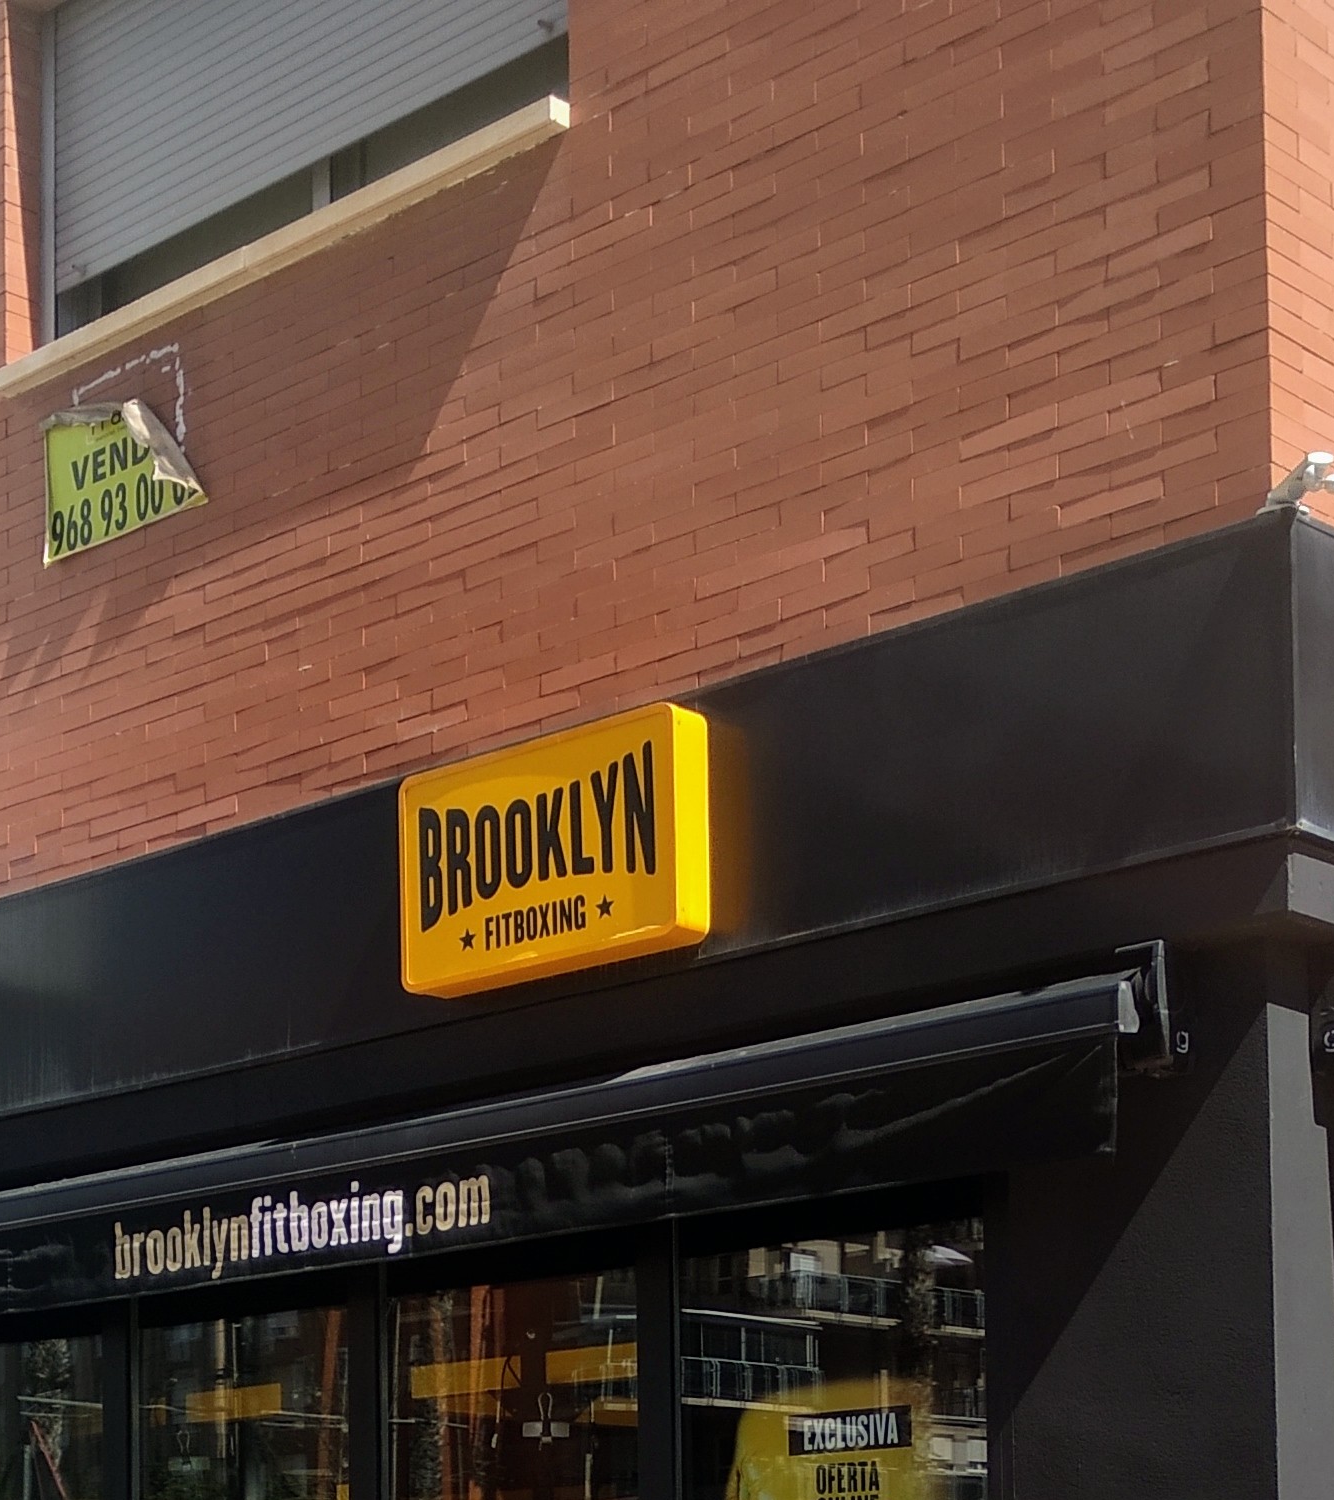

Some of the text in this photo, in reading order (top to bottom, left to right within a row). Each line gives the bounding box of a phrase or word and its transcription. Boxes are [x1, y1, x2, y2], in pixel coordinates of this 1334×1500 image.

[51, 497, 93, 557] 968
[100, 482, 128, 537] 93
[418, 739, 657, 934] BROOKLYN
[484, 895, 586, 952] FITBOXING
[114, 1172, 492, 1280] brooklynfitboxing.com
[803, 1412, 899, 1451] EXCLUSIVA
[816, 1460, 880, 1495] OFERTA
